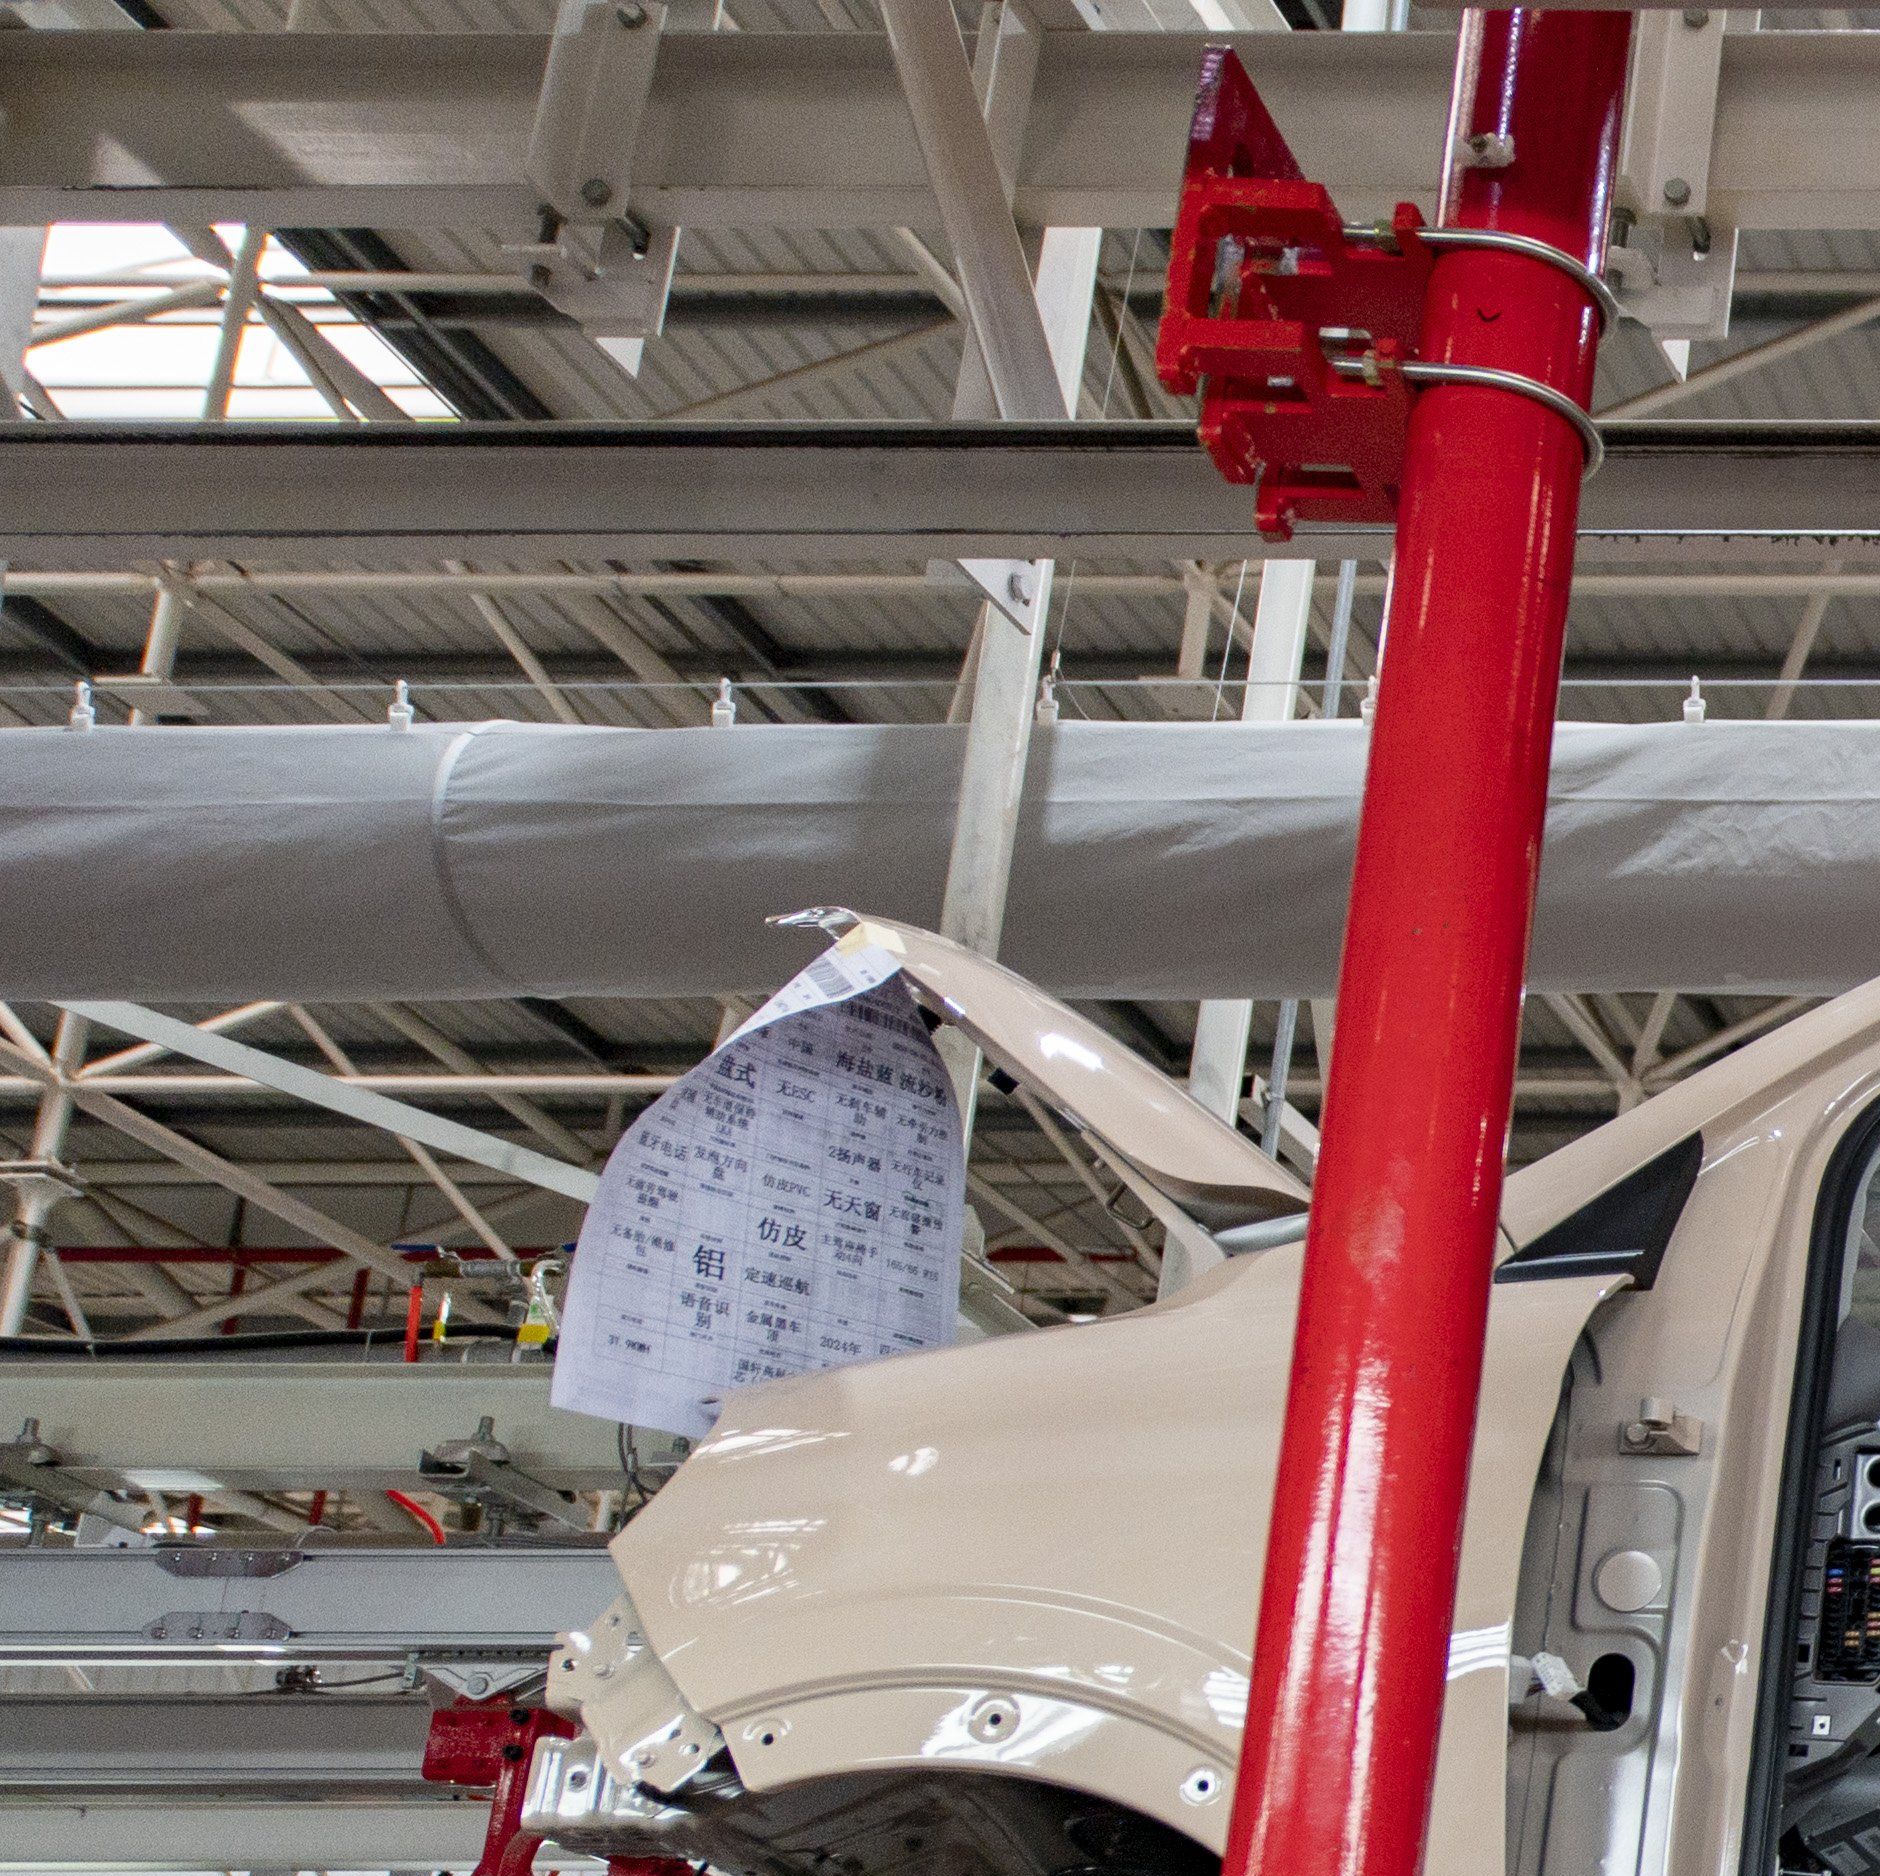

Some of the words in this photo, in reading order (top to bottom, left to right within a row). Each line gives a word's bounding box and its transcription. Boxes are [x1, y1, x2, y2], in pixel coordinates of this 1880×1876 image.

[823, 1188, 882, 1223] 无天窗
[758, 1216, 808, 1252] 仿皮
[693, 1244, 726, 1281] 铝
